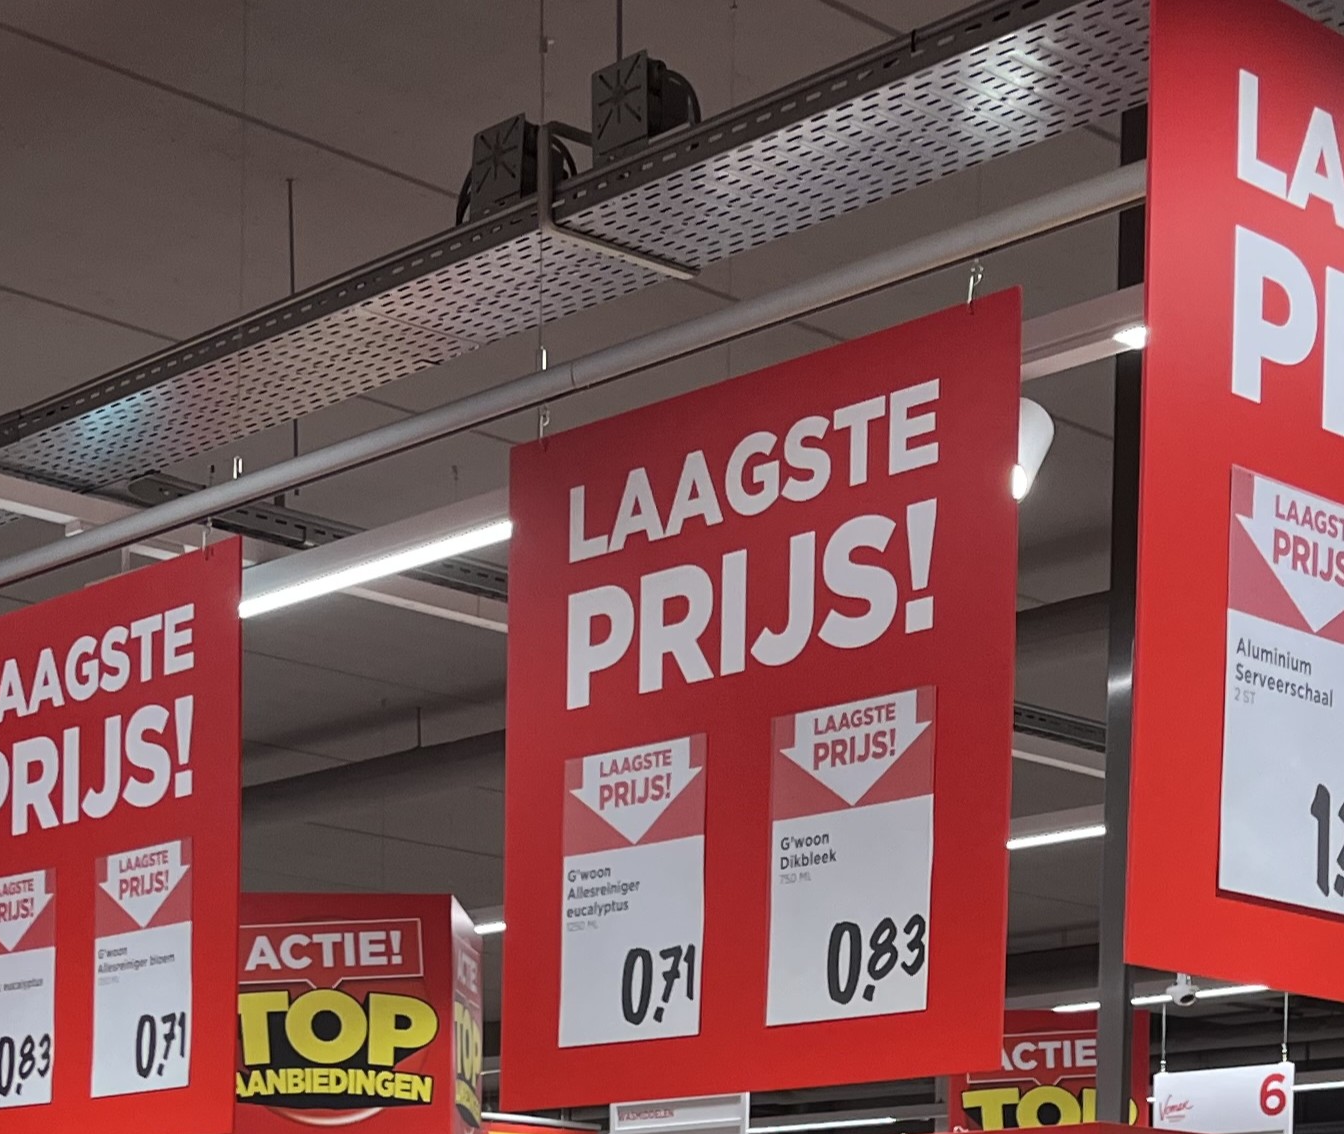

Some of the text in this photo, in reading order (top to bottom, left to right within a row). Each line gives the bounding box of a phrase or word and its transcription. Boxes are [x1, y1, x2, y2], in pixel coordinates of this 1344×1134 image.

[568, 378, 941, 564] LAAGSTE
[566, 497, 938, 711] PRIJS!
[1236, 637, 1313, 677] Aluminium
[1234, 663, 1334, 708] Serveerschaal
[813, 702, 896, 736] LAAGSTE
[599, 748, 672, 778] LAAGSTE
[812, 727, 897, 771] PRIJS!
[598, 772, 672, 811] PRIJS!
[779, 849, 837, 870] Dikbleek
[780, 832, 830, 851] G'woon
[119, 850, 169, 874] LAAGSTE
[567, 865, 611, 883] G'woon
[119, 870, 169, 900] PRIJS!
[567, 879, 640, 900] Allesreiniger
[566, 899, 629, 919] eucalyptus
[244, 930, 404, 972] ACTIE!
[826, 913, 926, 1005] 0.83
[621, 943, 696, 1026] 0.71
[135, 1011, 186, 1079] 0.71
[237, 988, 439, 1067] TOP
[235, 1068, 433, 1103] AANBIEDINGEN
[1259, 1073, 1287, 1116] 6
